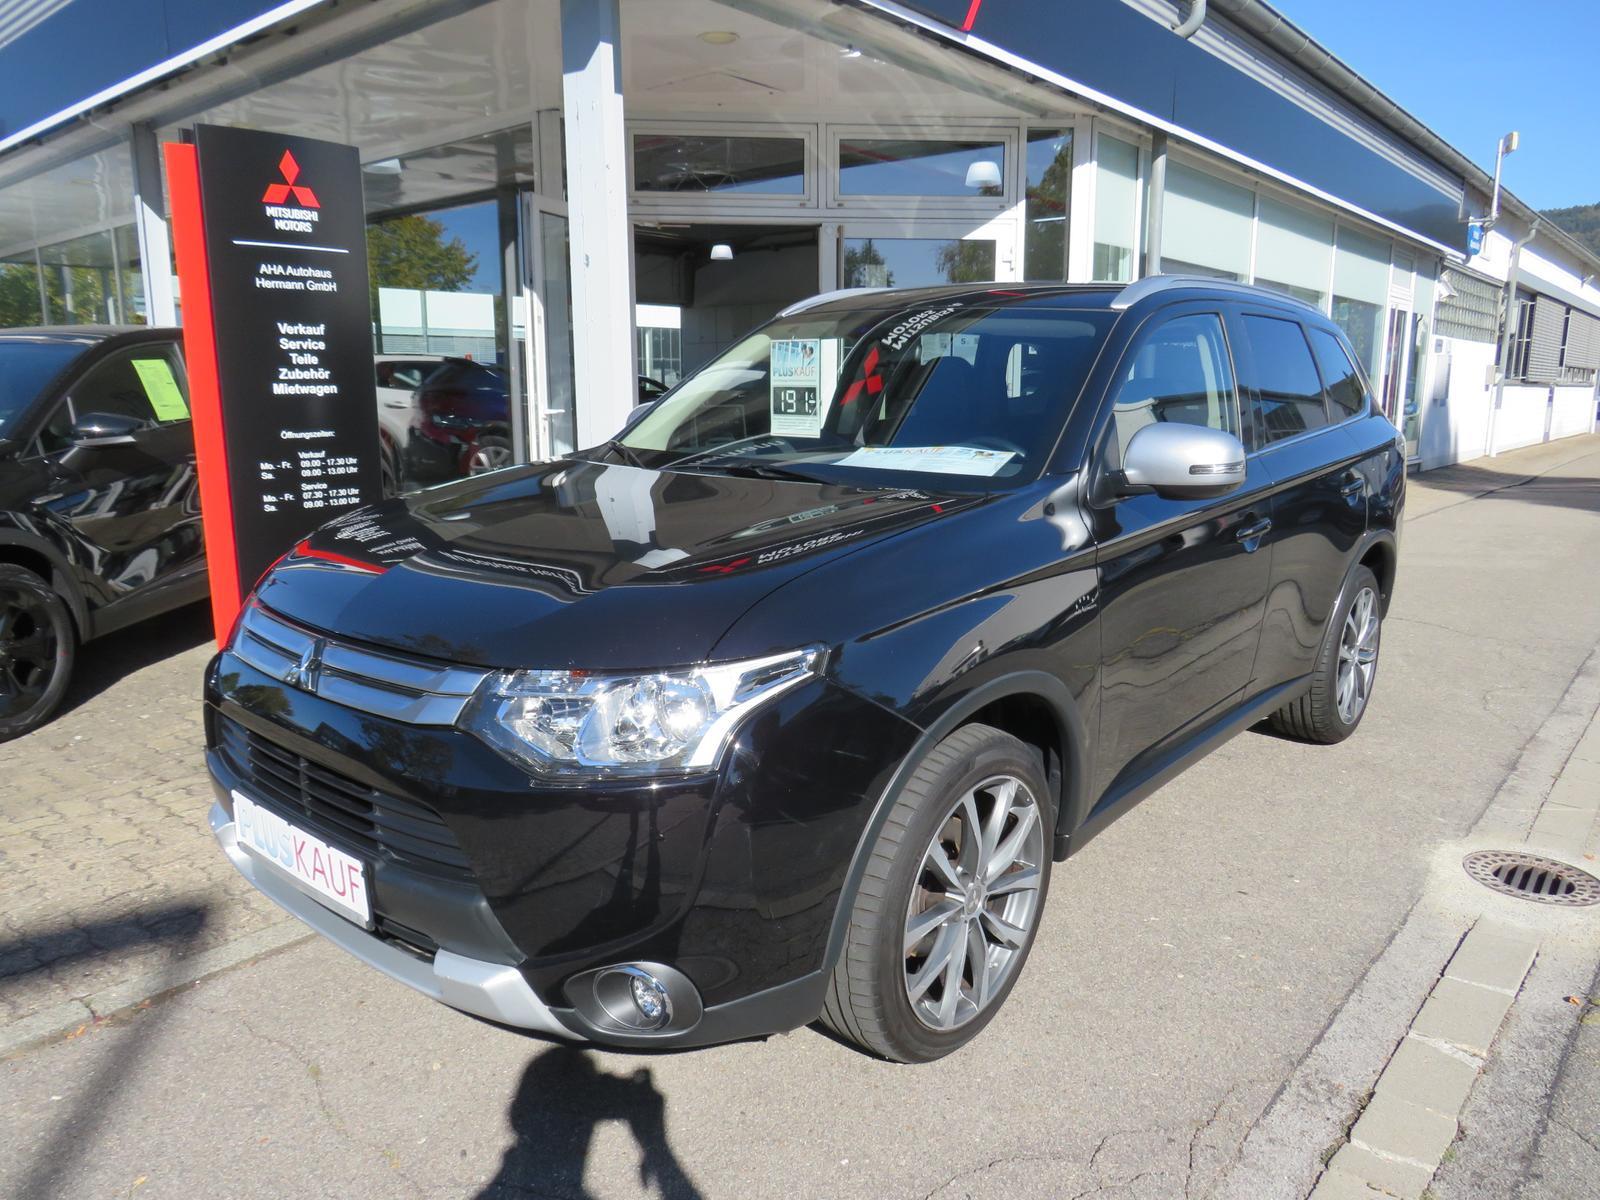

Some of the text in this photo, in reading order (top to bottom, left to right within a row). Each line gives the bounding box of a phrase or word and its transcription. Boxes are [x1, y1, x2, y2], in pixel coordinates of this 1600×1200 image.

[265, 206, 319, 221] MITSUBISHI
[274, 219, 313, 232] MOTORS
[259, 264, 332, 279] AHA Autohaus
[256, 277, 337, 292] Hermann GmbH
[277, 323, 325, 335] Verkauf
[279, 338, 326, 350] Service
[289, 353, 319, 365] Teile
[279, 368, 330, 379] Zubehör
[773, 367, 816, 377] PLUSKAUF
[273, 383, 338, 396] Mietwagen
[298, 450, 325, 459] Verkauf
[300, 460, 321, 468] 09.00
[327, 458, 345, 466] 17.30
[345, 457, 358, 465] Uhr
[301, 469, 322, 477] 09.00
[327, 467, 345, 475] 13.00
[346, 466, 359, 474] Uhr
[301, 483, 327, 491] Service
[303, 491, 323, 499] 07.30
[347, 488, 360, 496] Uhr
[303, 500, 324, 509] 09.00
[329, 498, 347, 506] 13.00
[348, 497, 361, 505] Uhr
[238, 807, 360, 903] PLUSKAUF
